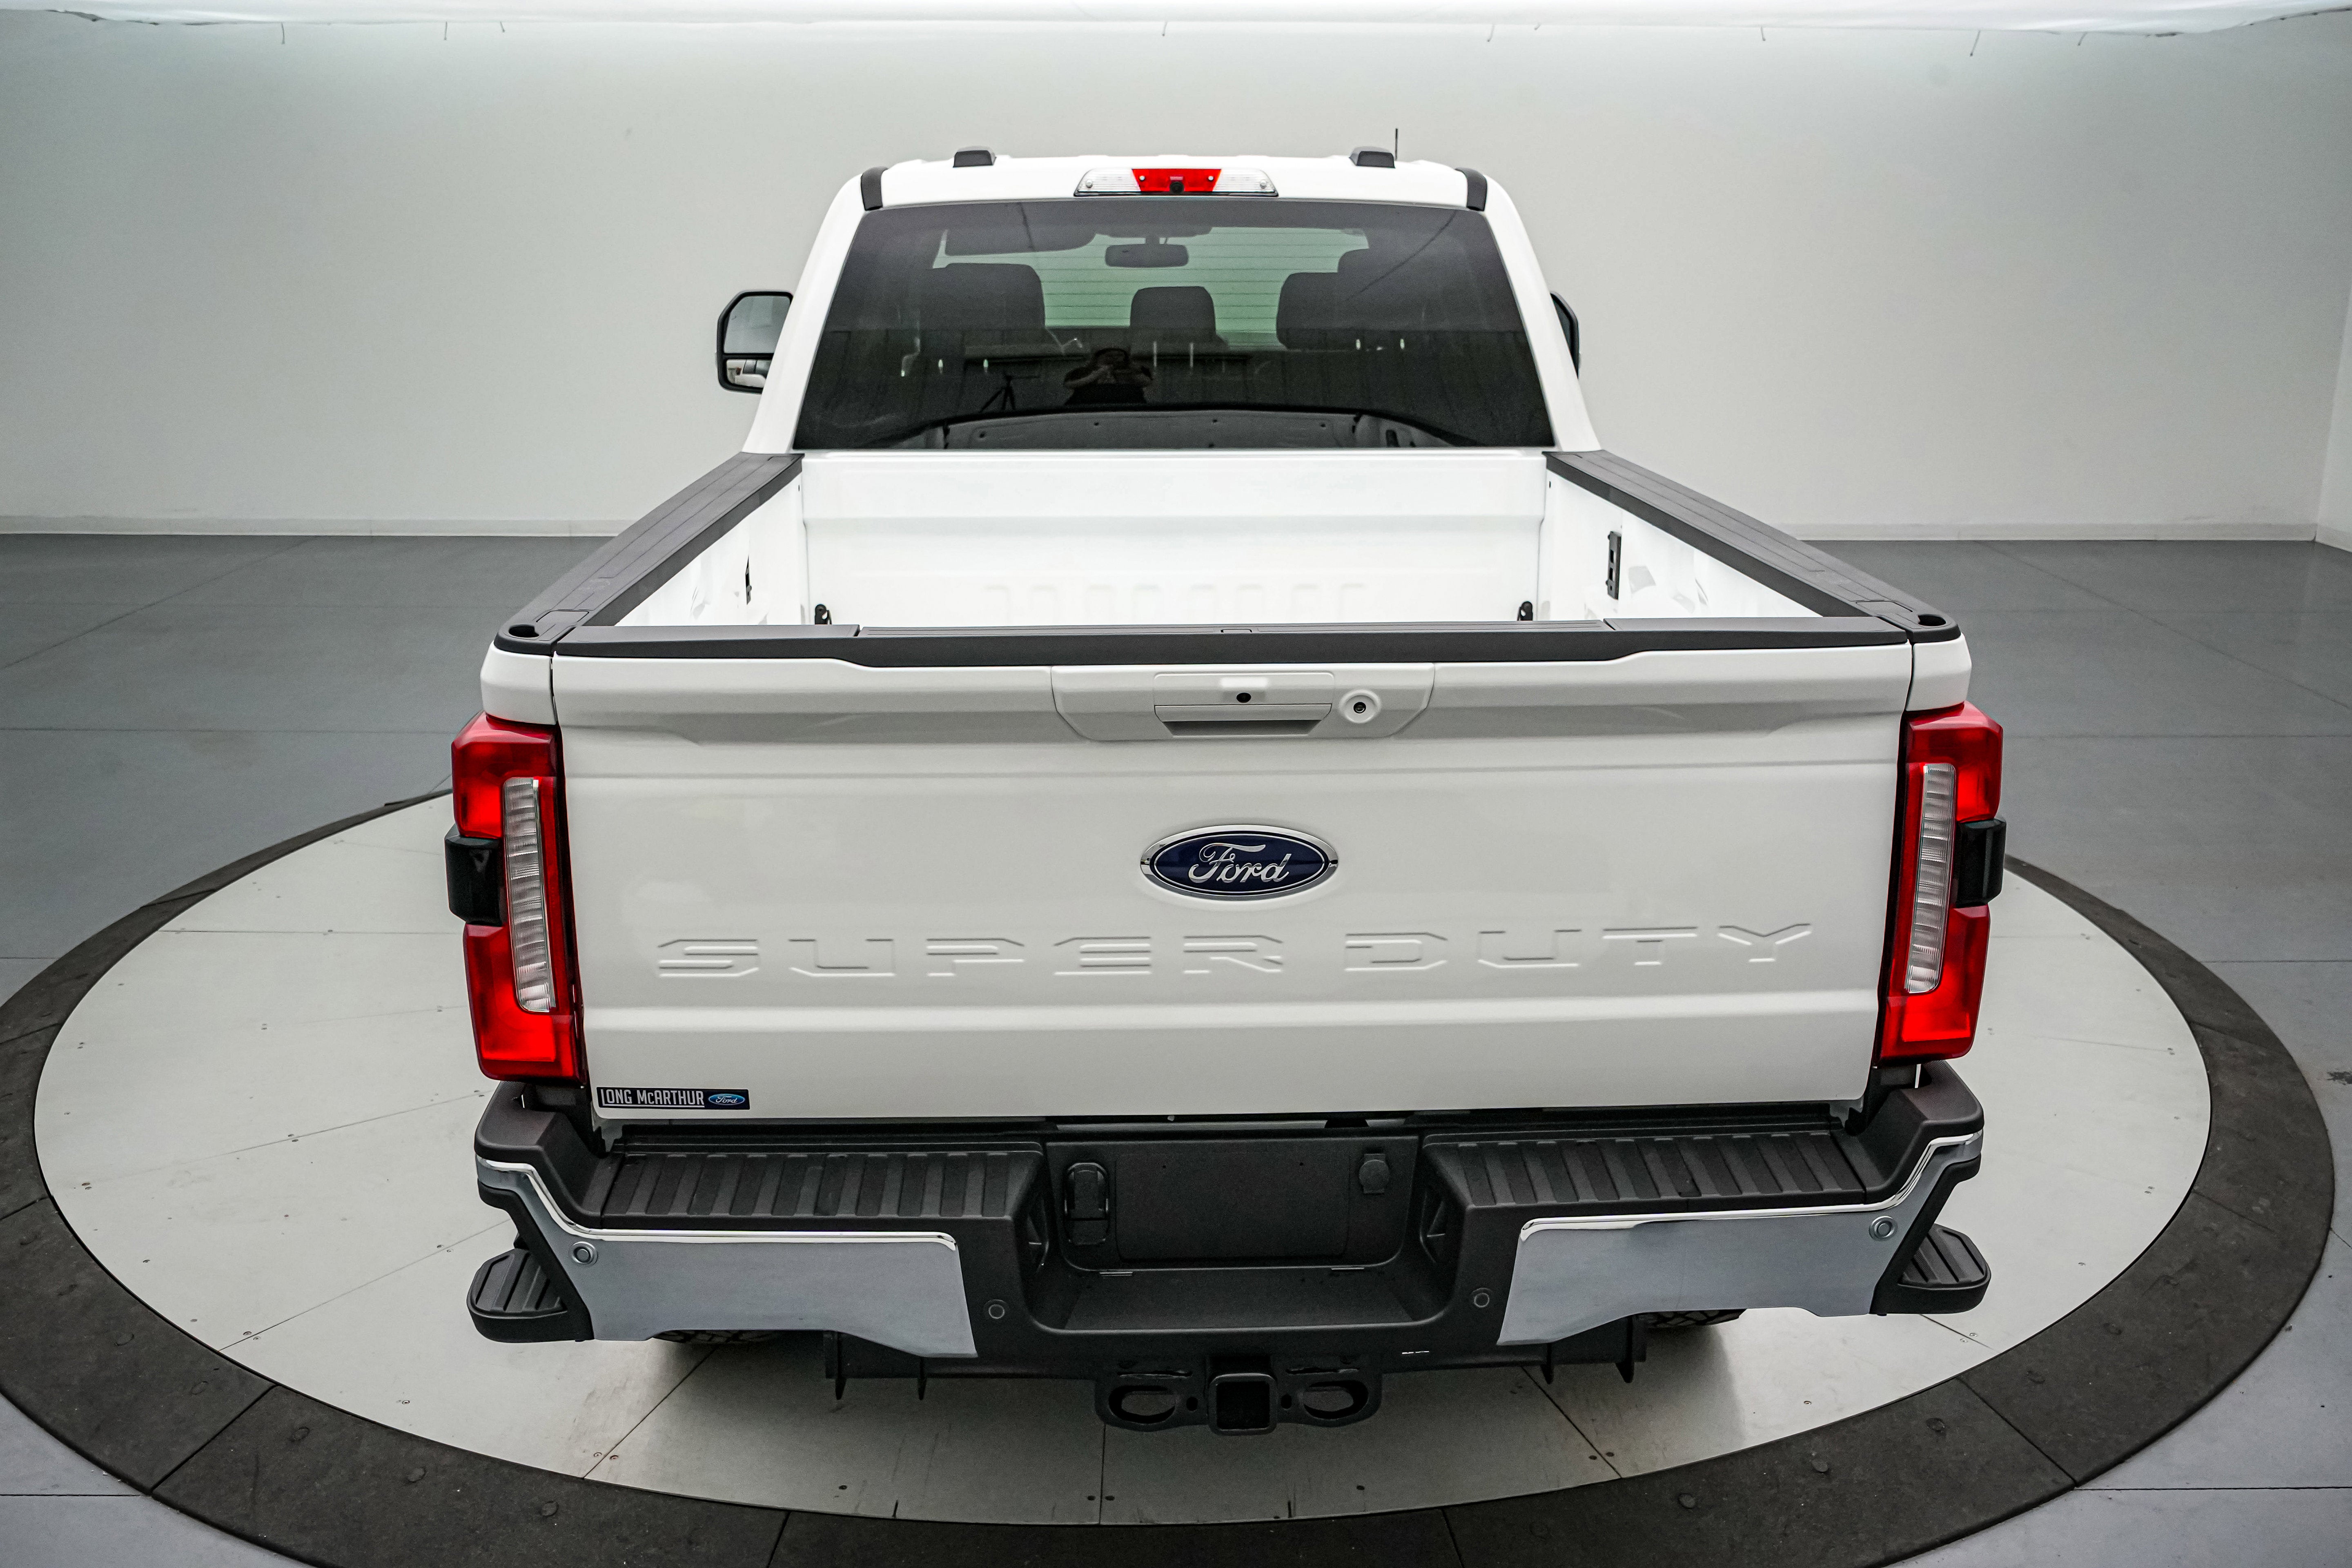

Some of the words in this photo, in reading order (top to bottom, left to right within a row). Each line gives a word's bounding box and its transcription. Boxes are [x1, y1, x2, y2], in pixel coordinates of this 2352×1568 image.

[1188, 842, 1292, 883] Ford
[657, 934, 1284, 978] SUPER
[1344, 922, 1813, 972] DUTY
[600, 1089, 632, 1106] LONG
[637, 1090, 704, 1105] McARTHUR
[716, 1096, 737, 1104] Ford
